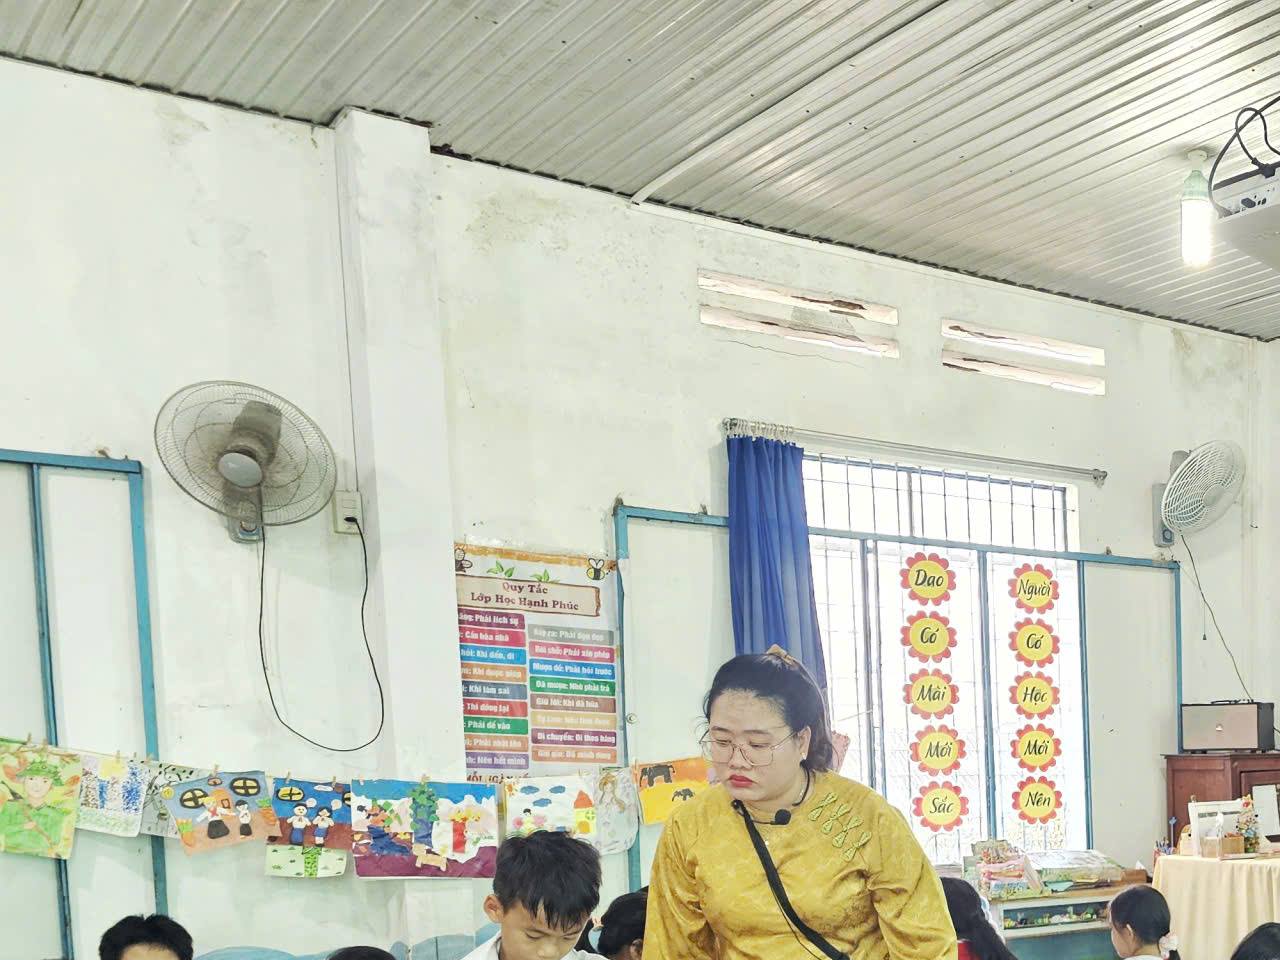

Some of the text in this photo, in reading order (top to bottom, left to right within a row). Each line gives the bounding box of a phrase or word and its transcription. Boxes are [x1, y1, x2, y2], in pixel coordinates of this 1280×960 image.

[914, 568, 944, 587] Dao
[502, 581, 524, 594] Quy
[1018, 579, 1051, 600] Người
[470, 592, 579, 611] Lớp Học Hạnh Phúc
[920, 626, 940, 644] Có
[1026, 633, 1044, 650] Có
[917, 684, 946, 702] Mài
[1022, 685, 1047, 706] Học
[924, 740, 952, 758] Mới
[1023, 738, 1048, 755] Mới
[929, 796, 953, 814] Sắc
[1024, 791, 1051, 809] Nên
